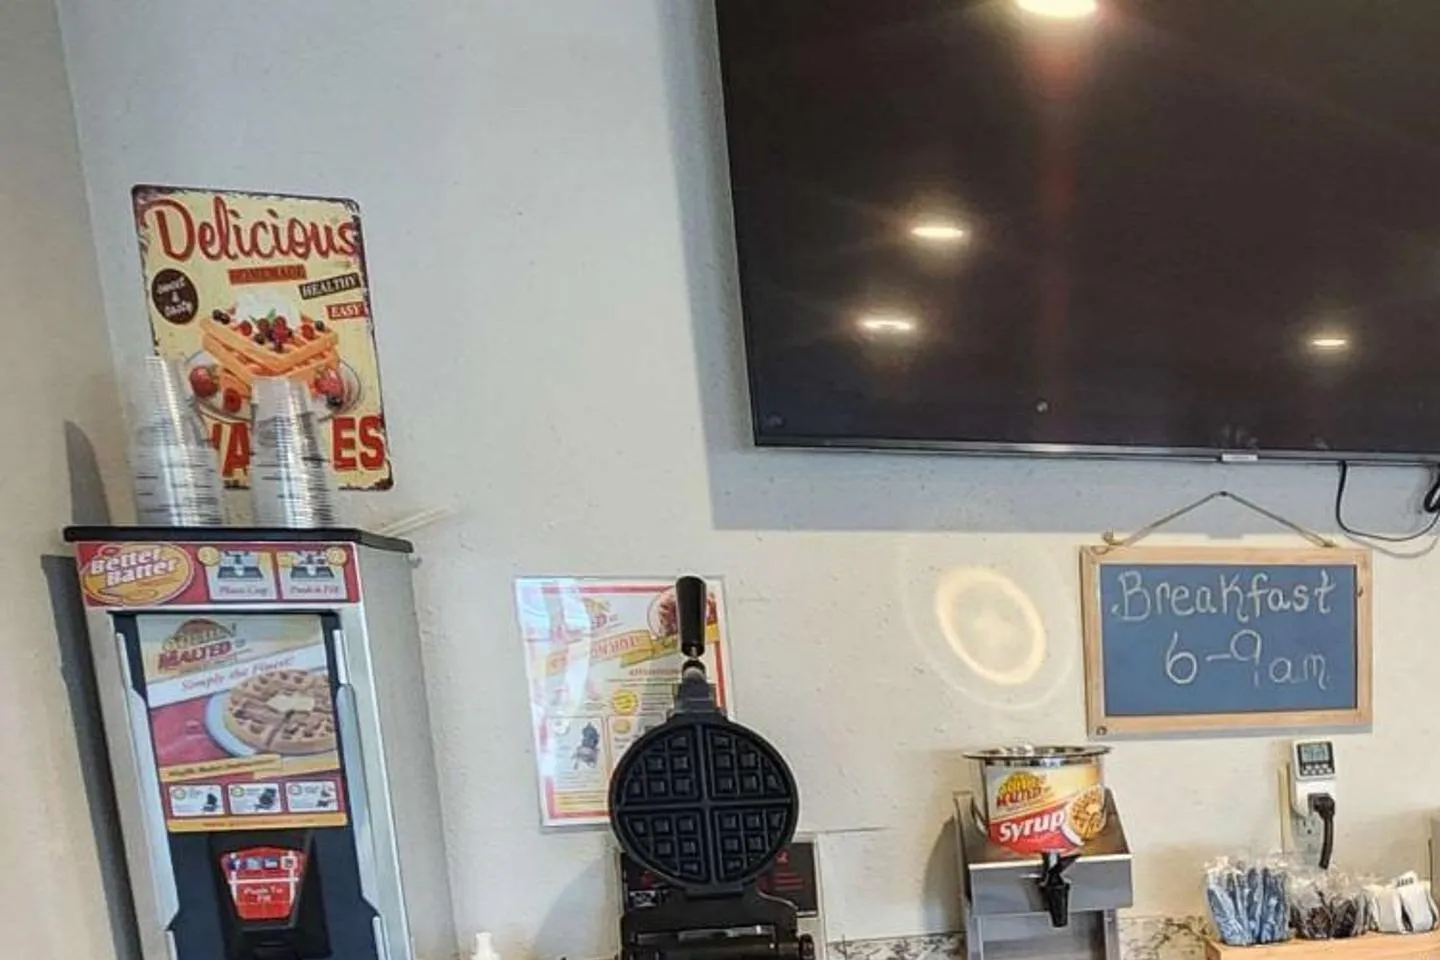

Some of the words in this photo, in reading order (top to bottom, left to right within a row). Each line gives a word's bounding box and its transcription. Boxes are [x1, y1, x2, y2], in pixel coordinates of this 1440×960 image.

[144, 196, 357, 261] Delicious
[302, 275, 358, 298] HEALTHY
[331, 303, 364, 317] EASY
[1111, 569, 1336, 622] Breakfast
[158, 641, 231, 670] MALTED
[999, 810, 1065, 843] Syrup
